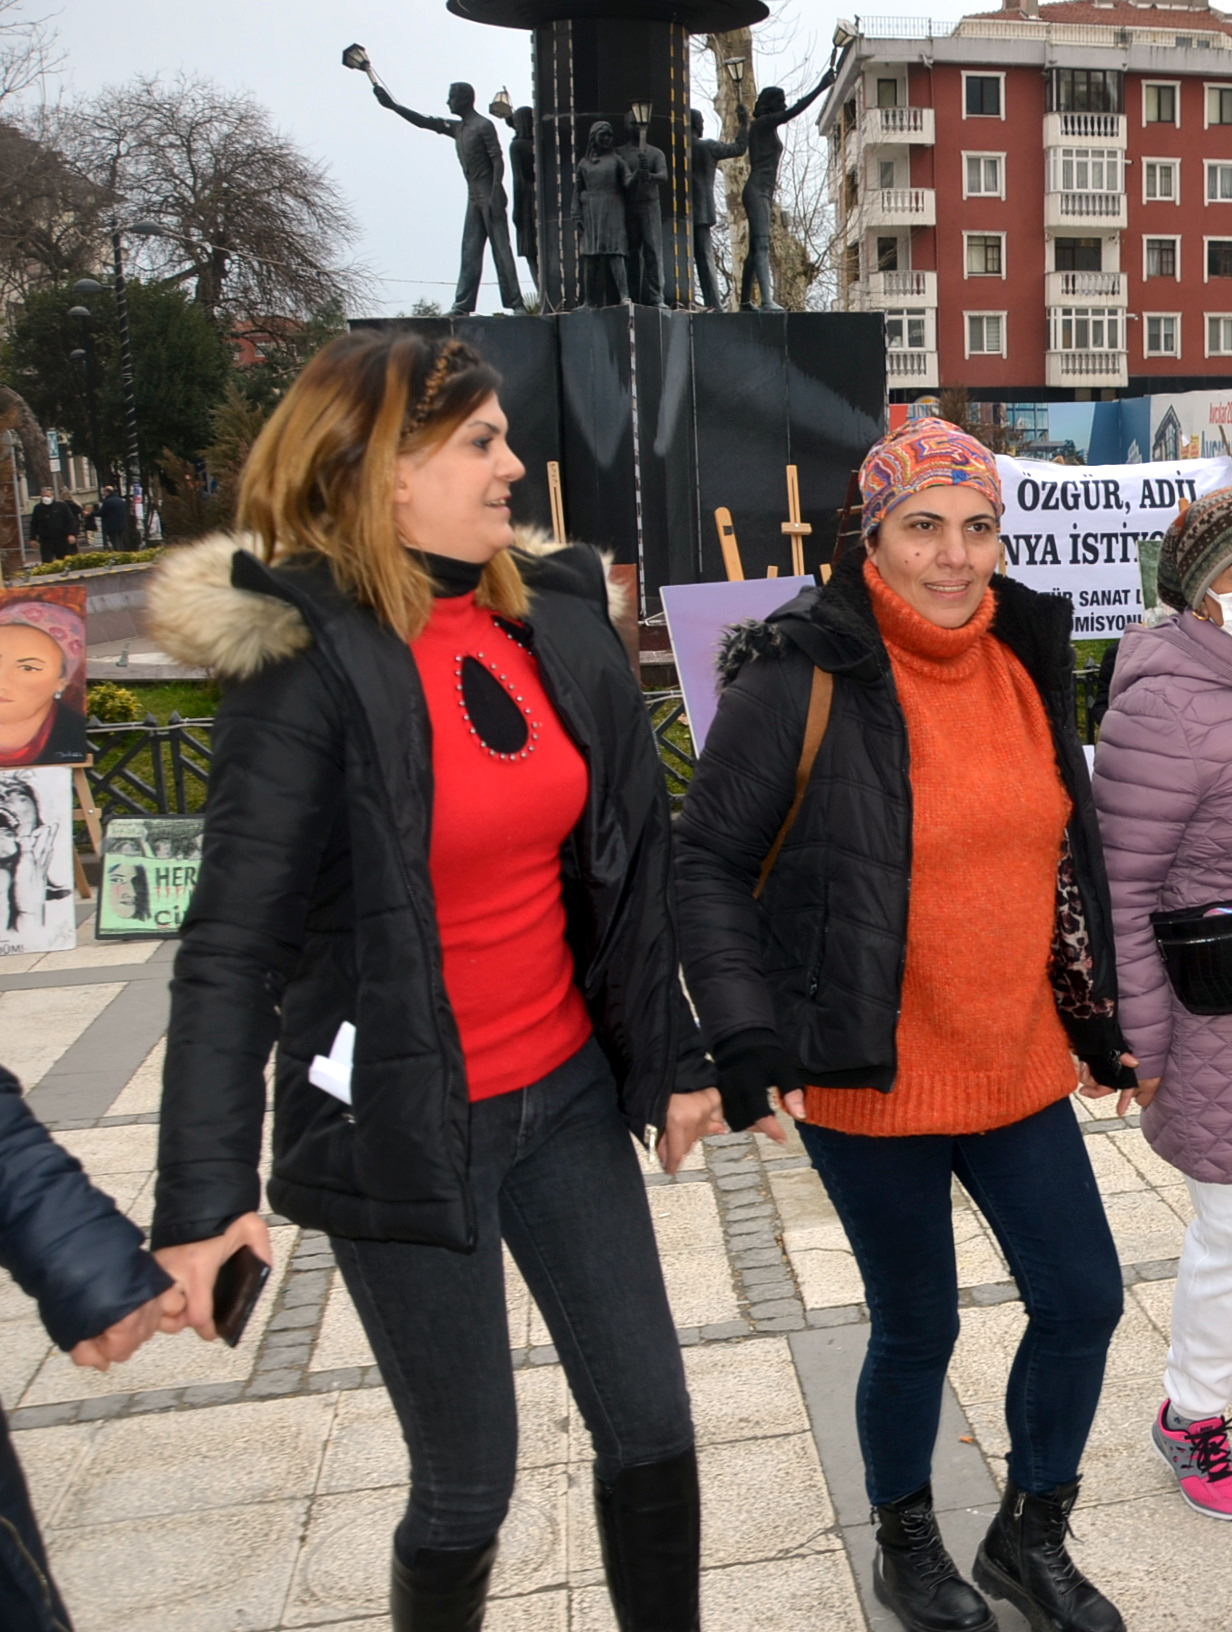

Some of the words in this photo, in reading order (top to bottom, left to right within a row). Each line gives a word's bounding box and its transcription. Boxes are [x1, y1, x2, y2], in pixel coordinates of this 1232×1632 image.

[1017, 471, 1131, 514] ÖZGÜR,
[1079, 589, 1131, 607] SANAT
[155, 866, 198, 887] HER
